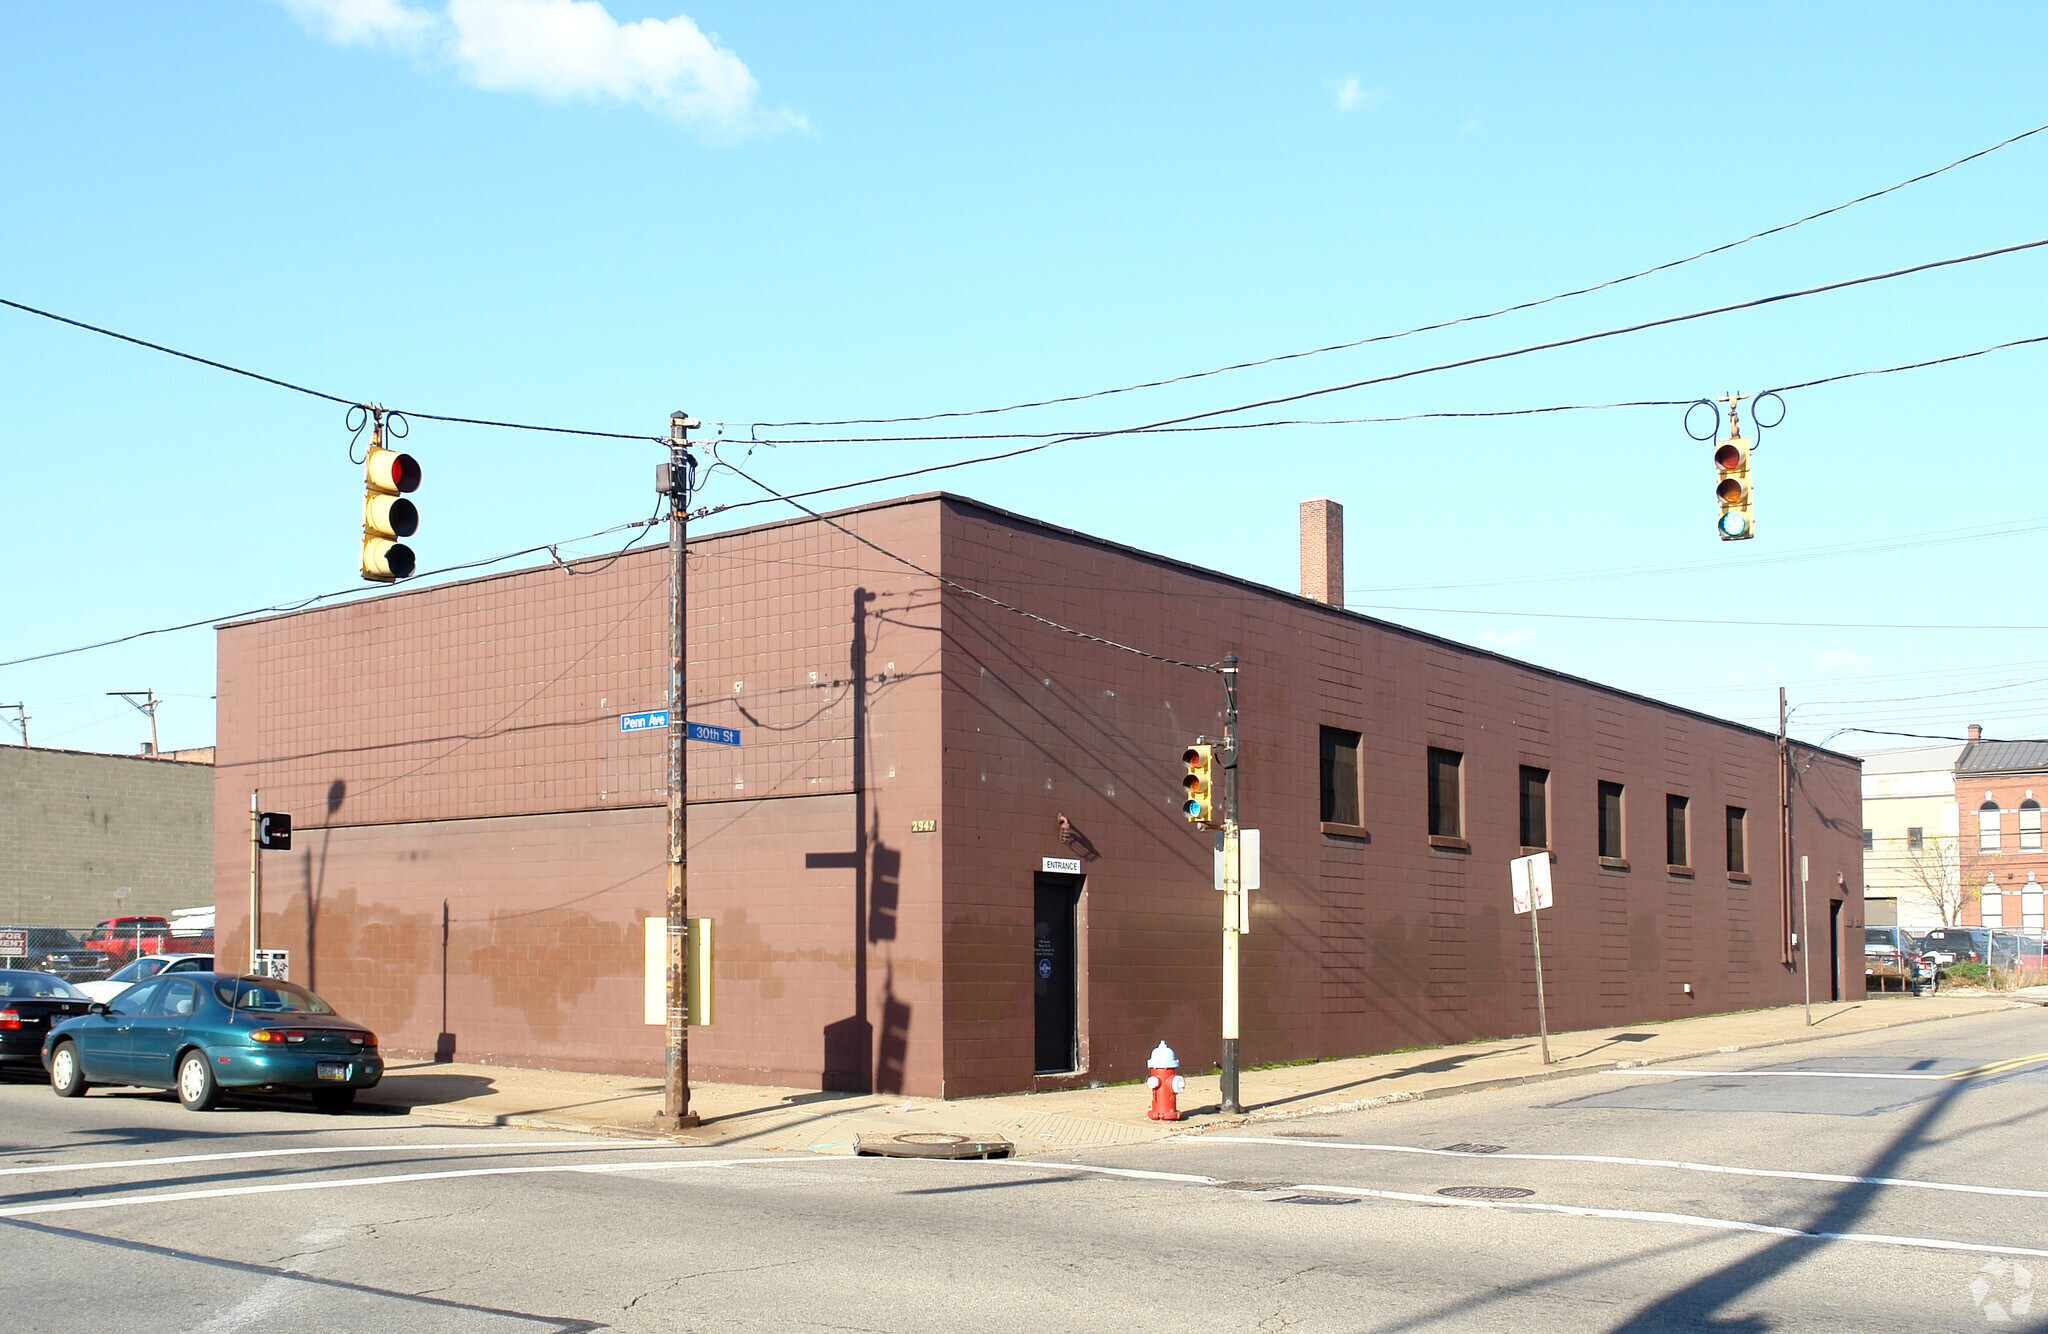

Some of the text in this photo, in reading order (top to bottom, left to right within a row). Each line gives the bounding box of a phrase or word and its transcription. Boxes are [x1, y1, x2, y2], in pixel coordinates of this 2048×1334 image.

[623, 714, 665, 729] Penn Ave
[696, 727, 734, 743] 30th St
[912, 820, 935, 831] 2947
[1046, 861, 1077, 870] ENTRANCE
[0, 932, 23, 940] FOR
